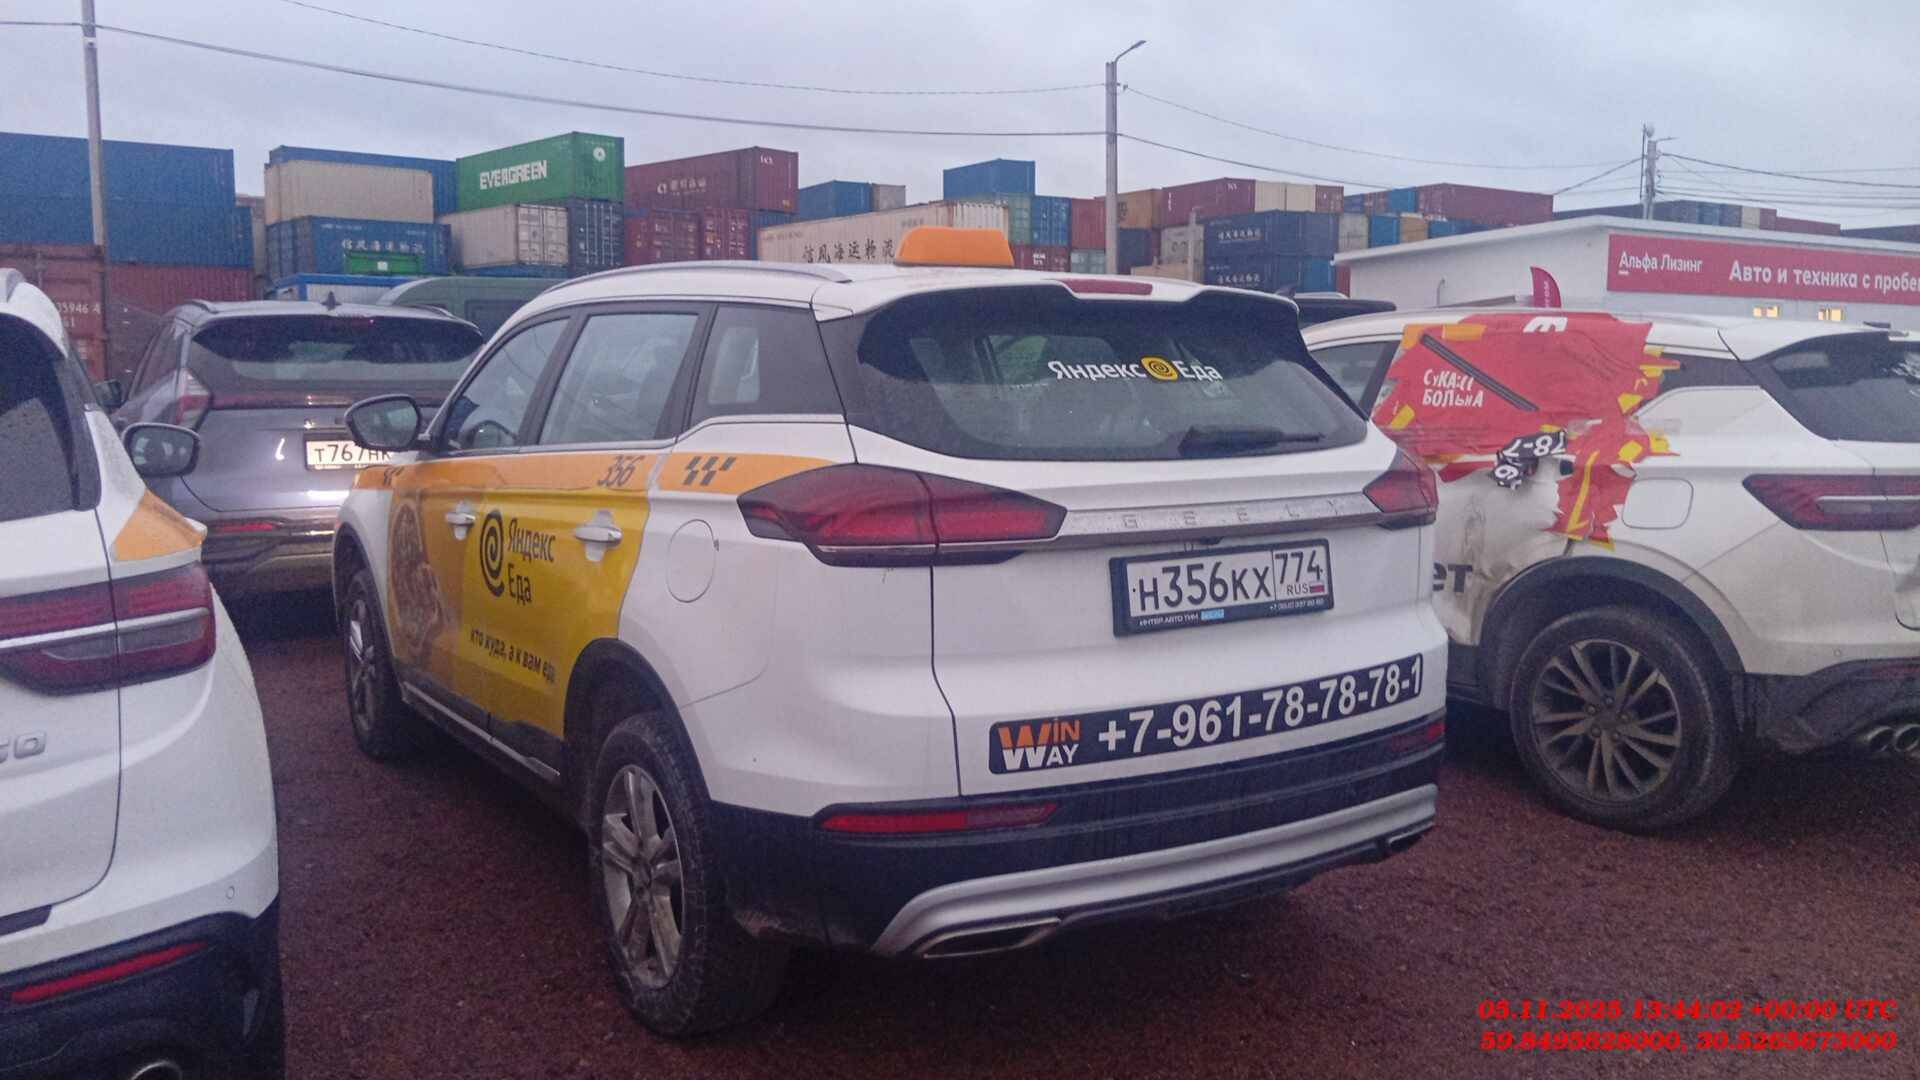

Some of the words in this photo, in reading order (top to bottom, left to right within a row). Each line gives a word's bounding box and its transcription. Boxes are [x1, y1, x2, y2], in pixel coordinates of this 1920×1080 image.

[480, 160, 547, 190] EVERGREEN
[1619, 250, 1658, 273] Альфа
[1661, 253, 1704, 273] Лизинг
[1729, 259, 1772, 283] Авто
[1777, 267, 1788, 283] и
[1793, 267, 1858, 289] техника
[1862, 273, 1870, 289] с
[1047, 360, 1149, 381] Яндекс
[1172, 360, 1224, 382] Еда
[1121, 499, 1339, 529] GEELY
[508, 518, 556, 563] Яндекс
[508, 563, 533, 606] Еда
[1139, 561, 1271, 611] Н356КХ
[1275, 550, 1321, 585] 774
[1287, 583, 1309, 596] RUS
[470, 628, 485, 645] кто
[508, 646, 516, 662] а
[522, 651, 542, 673] вам
[1098, 656, 1423, 753] +7-961-78-78-78-1
[1000, 743, 1081, 772] WAY
